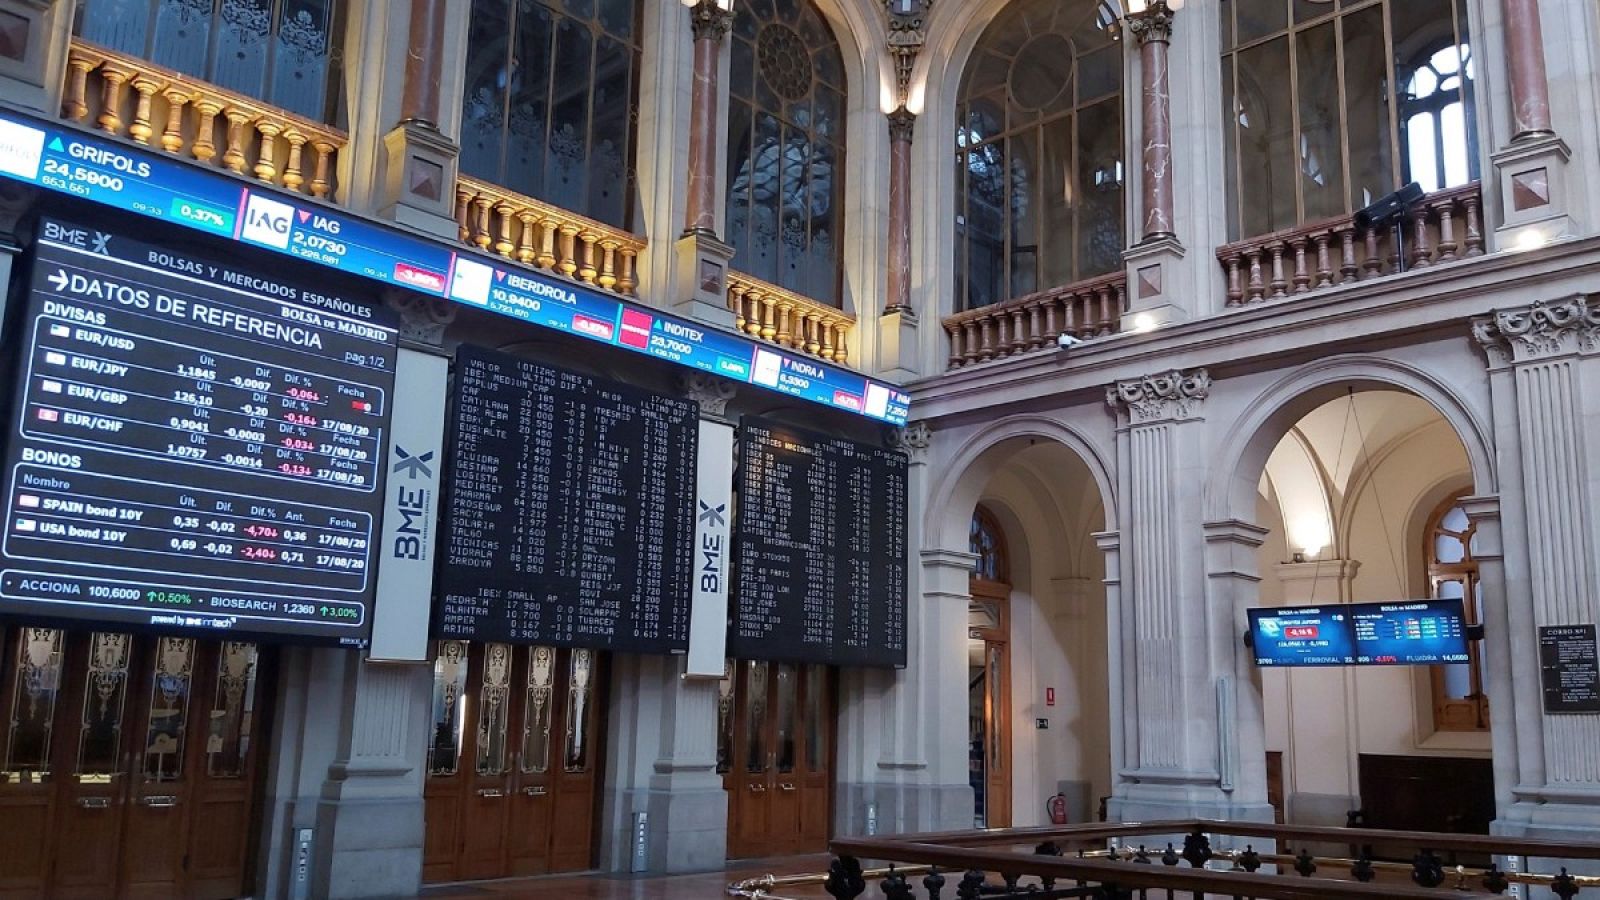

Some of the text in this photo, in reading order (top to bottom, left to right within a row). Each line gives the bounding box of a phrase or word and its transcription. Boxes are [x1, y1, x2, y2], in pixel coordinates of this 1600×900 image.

[69, 143, 150, 177] GRIFOLS
[249, 209, 288, 234] IAG
[313, 215, 341, 234] IAG
[44, 222, 88, 247] BME
[294, 232, 346, 256] 2,0730
[148, 251, 371, 318] BOLSAS Y MERCADOS ESPAÑOLES
[508, 274, 576, 305] IBERDROLA
[492, 289, 540, 311] 10,9400
[43, 301, 106, 325] DIVISAS
[70, 274, 322, 350] DATOS DE REFERENCIA
[282, 307, 321, 327] BOLSA
[338, 320, 387, 342] MADRID
[664, 322, 703, 343] INDITEX
[76, 328, 135, 350] EUR/USD
[651, 335, 691, 354] 23,7000
[72, 354, 128, 377] EUR/JPY
[200, 354, 365, 398] Últ. Dif. Dif. % Fecha
[791, 361, 824, 379] INDRA A
[68, 385, 128, 404] EUR/GBP
[177, 366, 312, 400] 1,1845 -0,0007 -0,06
[464, 376, 498, 391] APPLUS
[196, 380, 309, 412] Últ. Dif. Dif. %
[63, 412, 124, 432] EUR/CHF
[174, 391, 369, 437] 126,10 -0,20 -0,16 17/08/20
[193, 407, 360, 446] Últ. Dif. Dif. % Fecha
[170, 417, 367, 460] 0,9041 -0,0003 -0,03 17/08/20
[22, 448, 81, 468] BONOS
[191, 433, 357, 470] Últ. Dif. Dif. % Fecha
[168, 444, 365, 484] 1,0757 -0,0014 -0,13 17/08/20
[456, 471, 498, 484] LOGISTA
[456, 480, 503, 494] MEDIASET
[24, 474, 70, 489] Nombre
[180, 495, 197, 508] Últ.
[216, 500, 233, 512] Dif.
[285, 511, 304, 522] Ant.
[330, 517, 356, 528] Fecha
[454, 499, 502, 513] PROSEGUR
[43, 498, 366, 549] SPAIN bond 10Y 0,35 -0,02 -4,70 0,36 17/08/20
[395, 486, 424, 560] BME
[452, 518, 495, 530] SOLARIA
[453, 509, 483, 519] SACYR
[452, 528, 481, 538] TALGO
[452, 538, 499, 550] TECNICAS
[40, 522, 364, 569] USA bond 10Y 0,69 -0,02 -2,40 0,71 17/08/20
[450, 547, 492, 558] VIDRALA
[449, 556, 491, 567] ZARDOYA
[701, 533, 719, 592] BME
[20, 579, 357, 618] ACCIONA 100,6000 0,50% BIOSEARCH 1,2360 3,00%
[152, 614, 174, 625] powered
[177, 615, 184, 626] by
[444, 616, 475, 625] AMPER
[445, 606, 488, 616] ALANTRA
[443, 624, 474, 634] ARIMA
